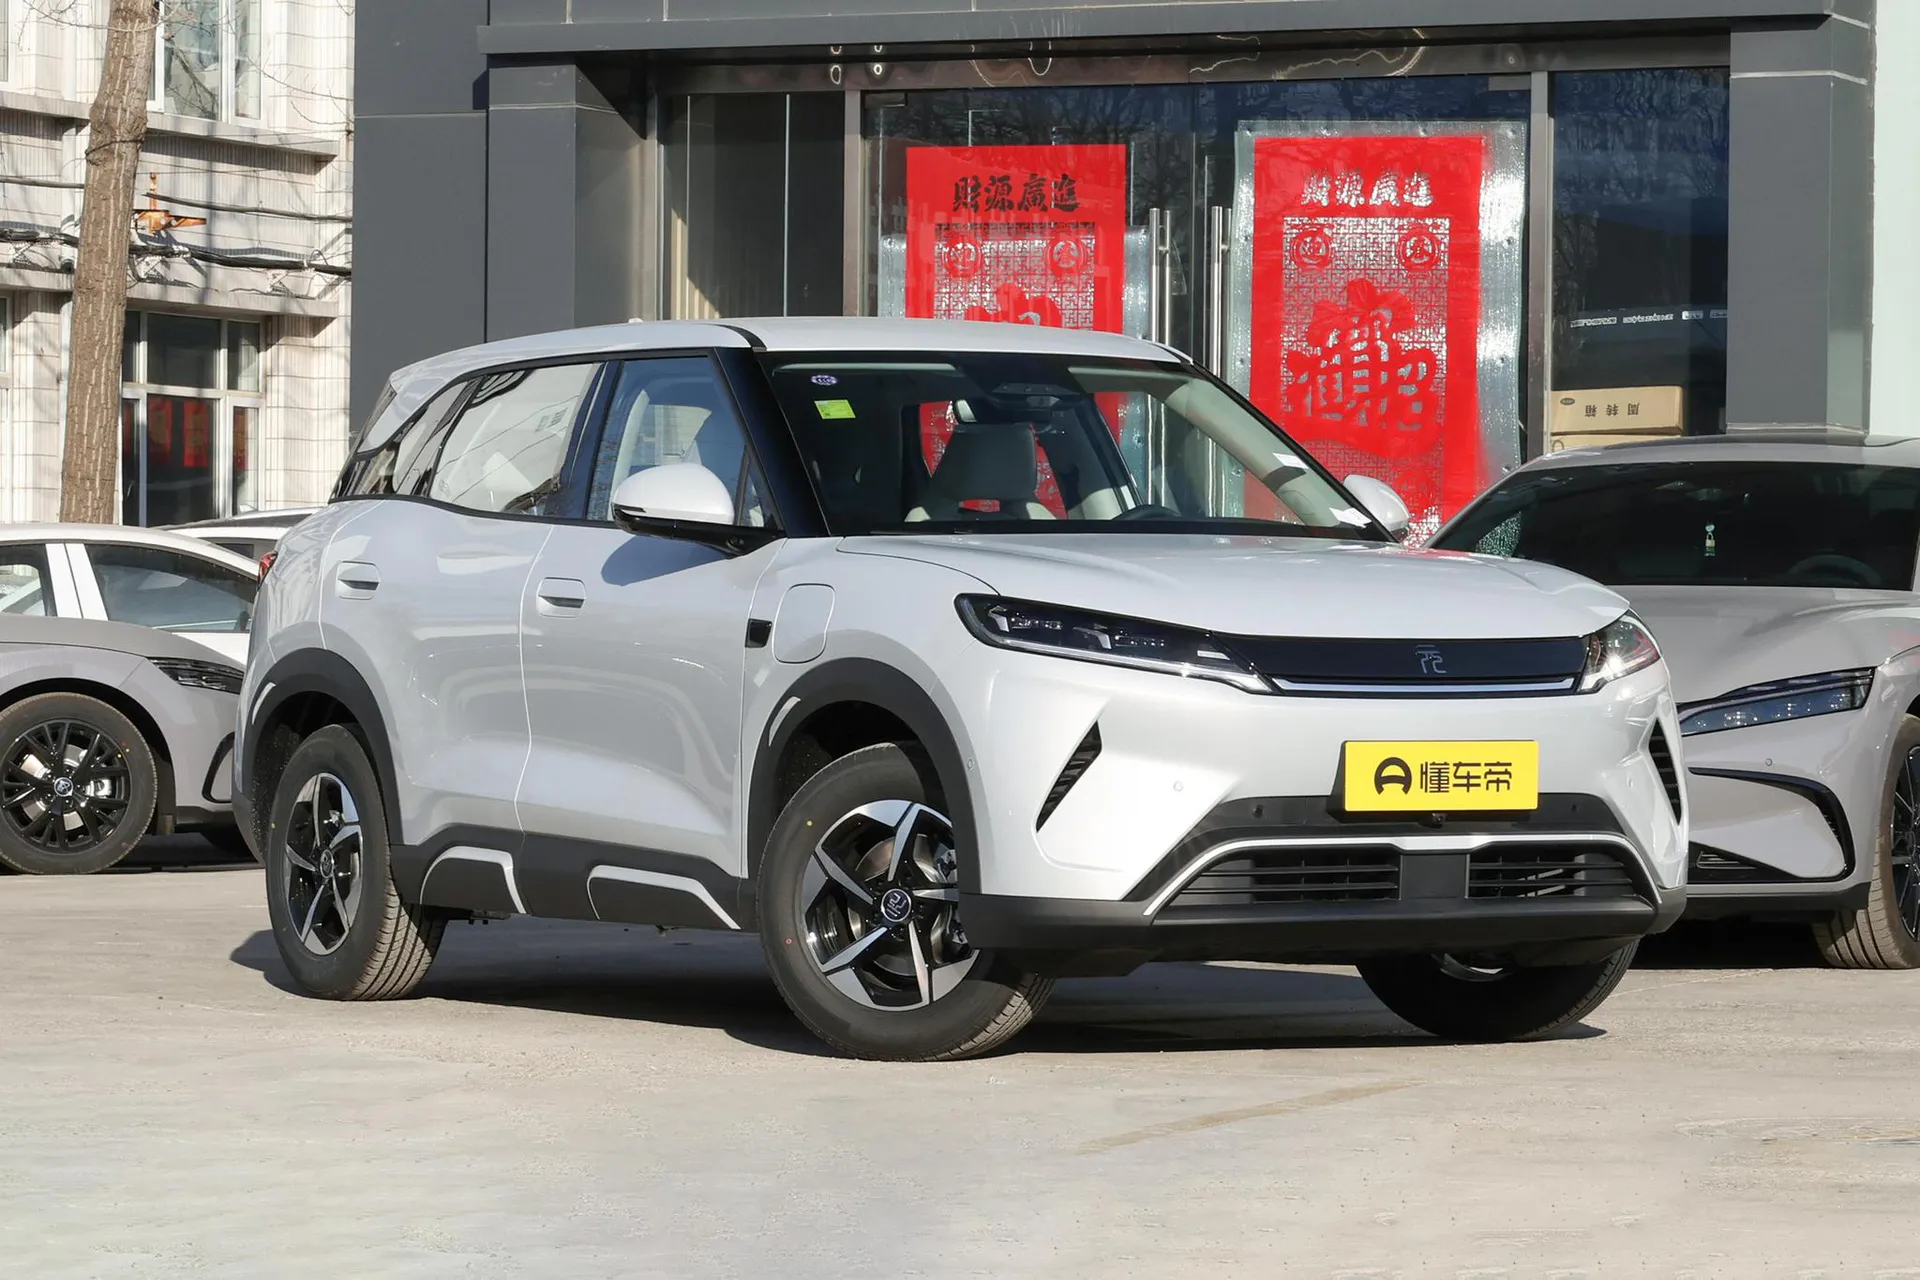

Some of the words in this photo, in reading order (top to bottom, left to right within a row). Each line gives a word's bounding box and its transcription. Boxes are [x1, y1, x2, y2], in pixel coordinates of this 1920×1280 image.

[953, 173, 1080, 213] 財源廣進
[1585, 402, 1640, 418] 周转箱
[1420, 761, 1512, 794] 懂车帝
